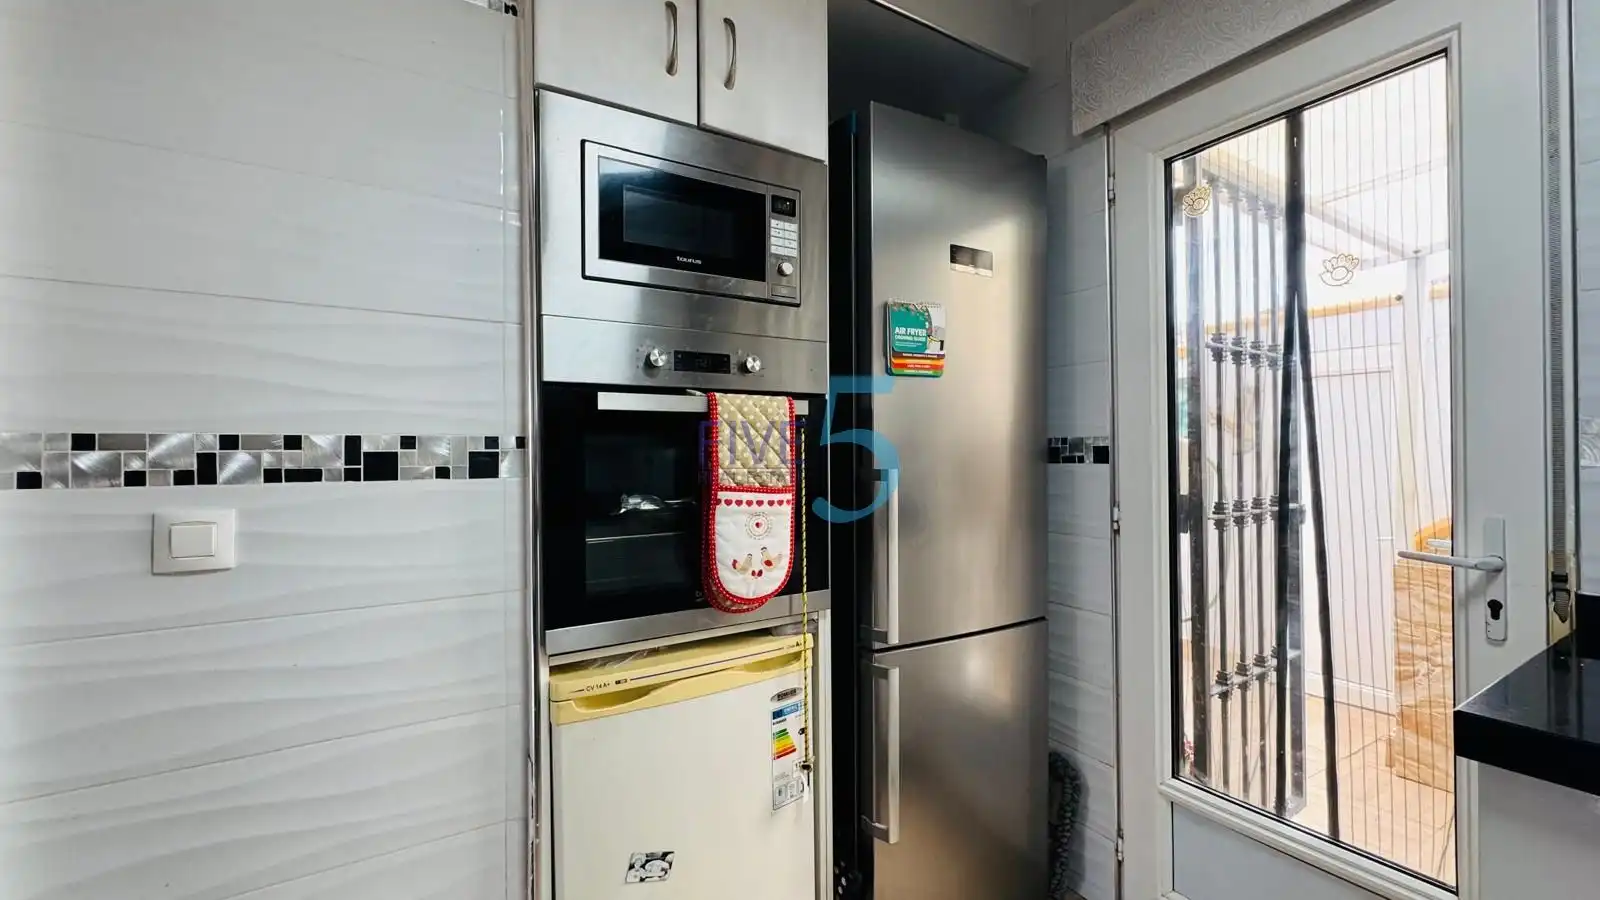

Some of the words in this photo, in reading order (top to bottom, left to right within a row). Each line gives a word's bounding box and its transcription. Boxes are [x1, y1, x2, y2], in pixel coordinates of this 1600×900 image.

[676, 255, 702, 265] taurus
[894, 326, 906, 335] AIR
[907, 327, 927, 337] FRYER
